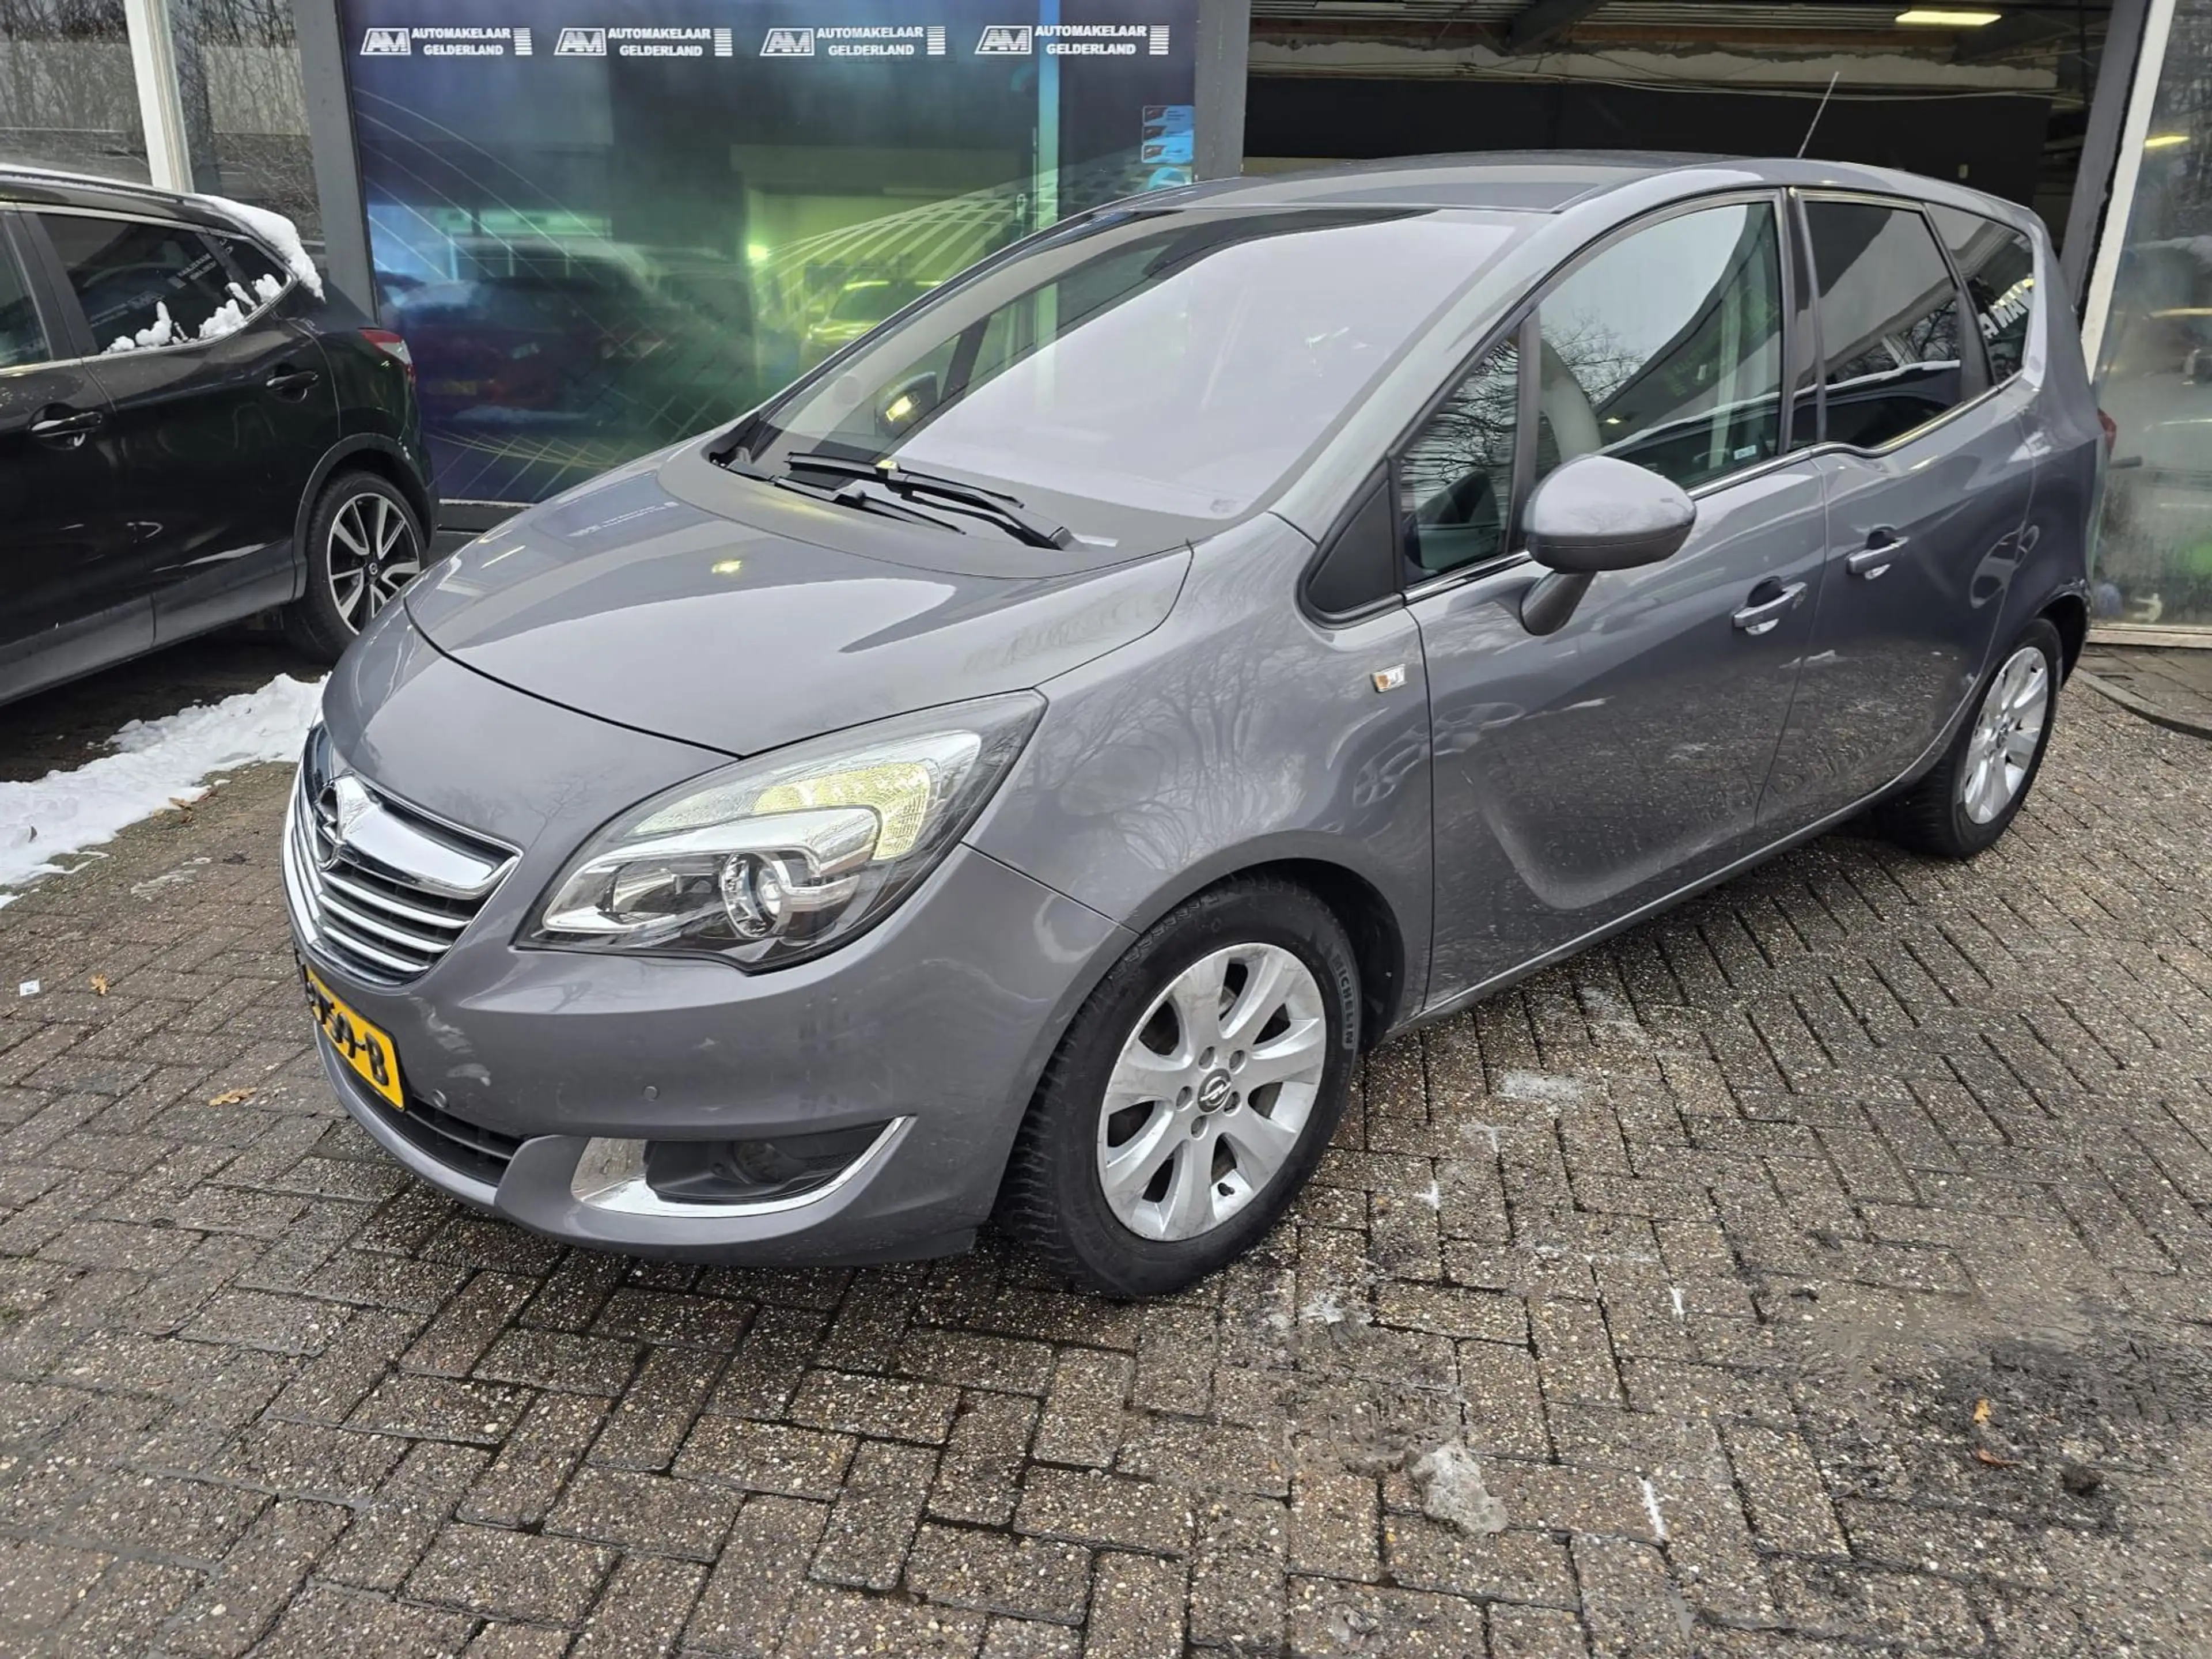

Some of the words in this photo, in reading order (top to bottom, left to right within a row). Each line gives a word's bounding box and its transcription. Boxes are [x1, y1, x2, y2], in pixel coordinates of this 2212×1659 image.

[411, 28, 511, 39] AUTOMAKELAAR
[608, 28, 711, 39] AUTOMAKELAAR
[816, 26, 923, 38] AUTOMAKELAAR
[1035, 25, 1147, 37] AUTOMAKELAAR
[423, 44, 504, 55] GELDERLAND
[619, 45, 703, 56] GELDERLAND
[828, 44, 915, 55] GELDERLAND
[1046, 44, 1137, 55] GELDERLAND
[1331, 953, 1354, 1045] MICHELIN
